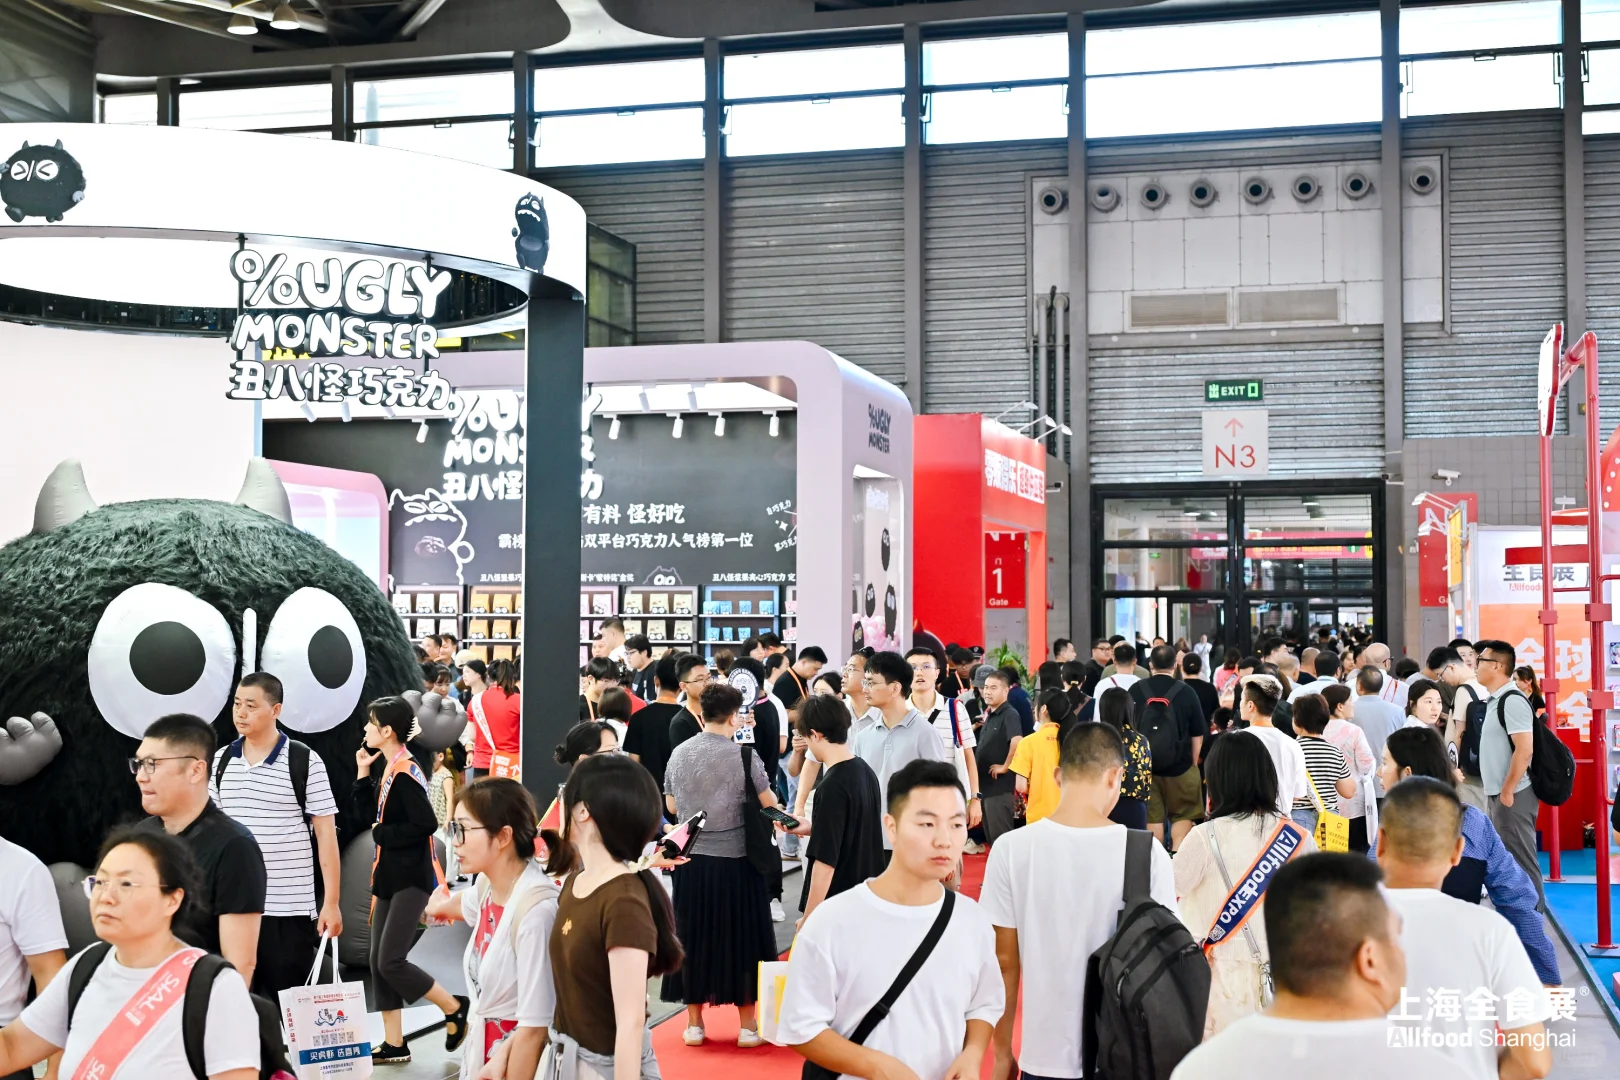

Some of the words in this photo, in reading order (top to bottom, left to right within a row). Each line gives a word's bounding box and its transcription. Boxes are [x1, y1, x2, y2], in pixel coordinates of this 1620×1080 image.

[231, 311, 441, 361] MONSTER
[227, 359, 451, 411] 丑八怪巧克力
[1221, 386, 1245, 395] EXIT
[868, 432, 890, 453] MONSTER
[1215, 444, 1255, 468] N3
[581, 504, 621, 525] 有料
[627, 503, 685, 524] 怪好吃
[992, 568, 1002, 594] 1
[989, 598, 1009, 606] Gate
